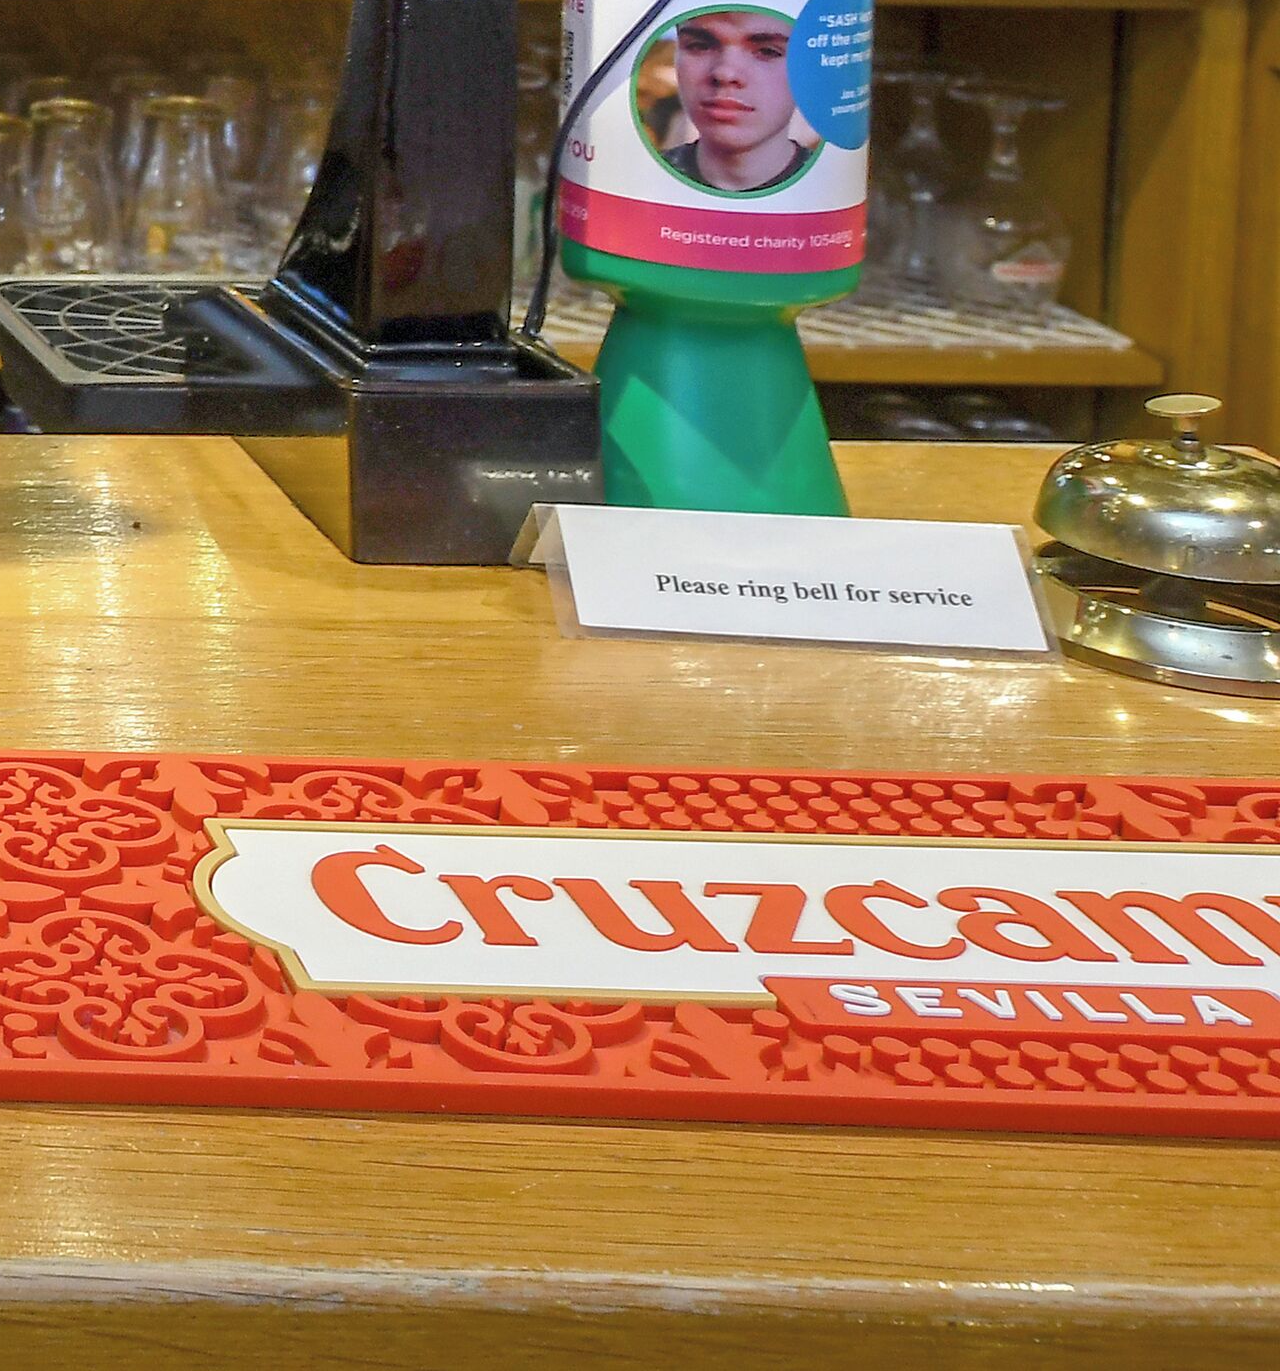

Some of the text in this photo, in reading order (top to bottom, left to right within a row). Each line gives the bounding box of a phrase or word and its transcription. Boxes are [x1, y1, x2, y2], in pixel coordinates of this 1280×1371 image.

[806, 33, 829, 48] off
[831, 33, 851, 47] the
[820, 53, 849, 68] kept
[660, 226, 750, 248] Registered
[754, 235, 806, 251] charity
[655, 574, 974, 608] Please ring bell for service
[310, 843, 1280, 969] Cruzcam
[829, 982, 1258, 1027] SEVILLA
